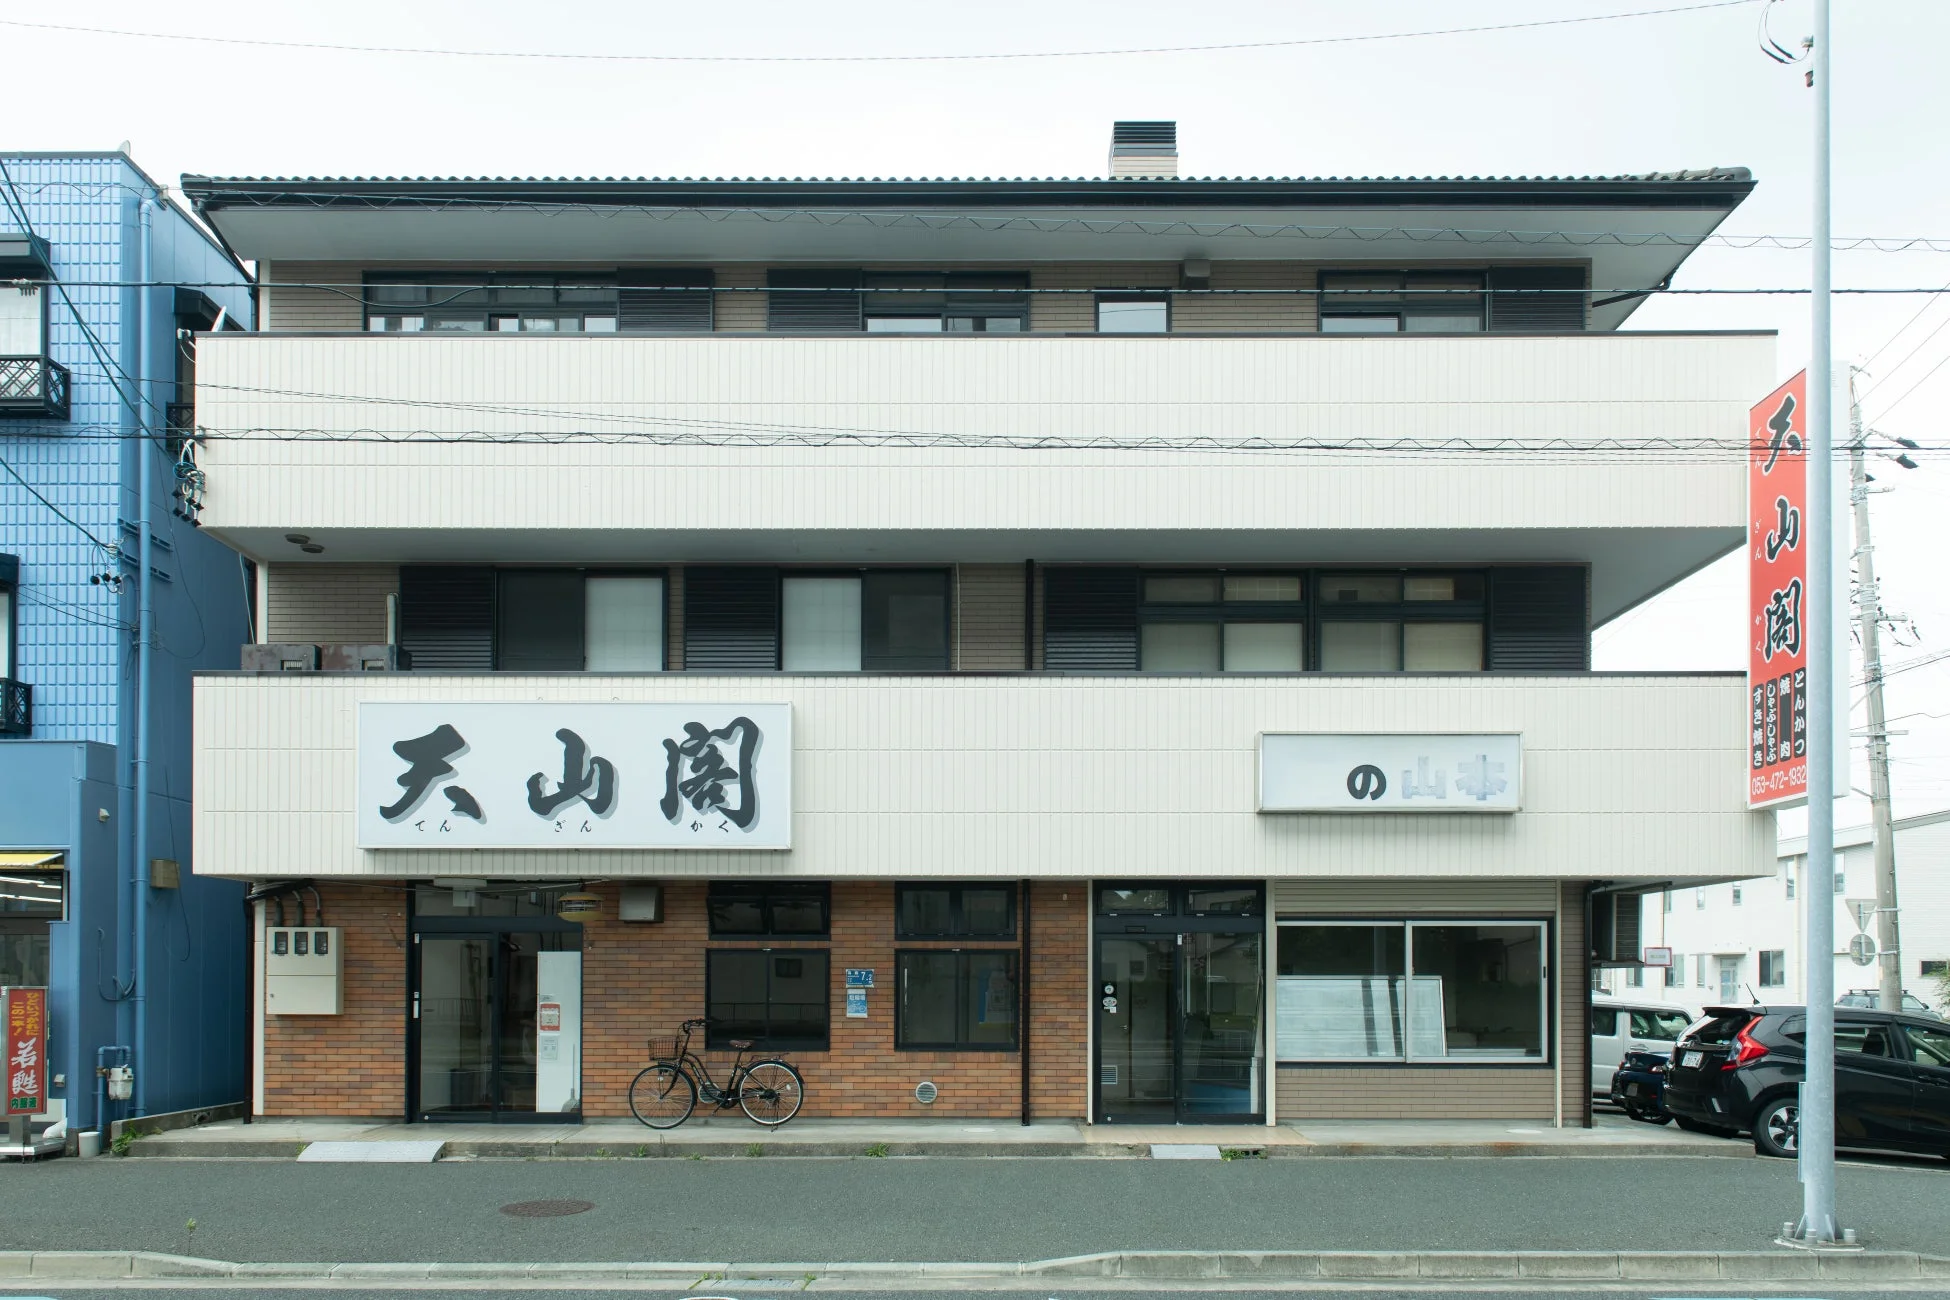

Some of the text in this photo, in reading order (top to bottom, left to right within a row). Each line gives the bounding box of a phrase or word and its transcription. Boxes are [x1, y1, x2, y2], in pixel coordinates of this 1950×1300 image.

[1763, 392, 1802, 663] 天山閣
[1753, 687, 1763, 767] すき焼き
[1766, 683, 1777, 763] しゃぶしゃぶ
[1779, 677, 1791, 758] 焼肉
[1794, 670, 1805, 754] とんかつ
[379, 716, 763, 832] 天山閣
[1752, 764, 1806, 796] 053-472-1932
[414, 819, 730, 833] てん ざん かく
